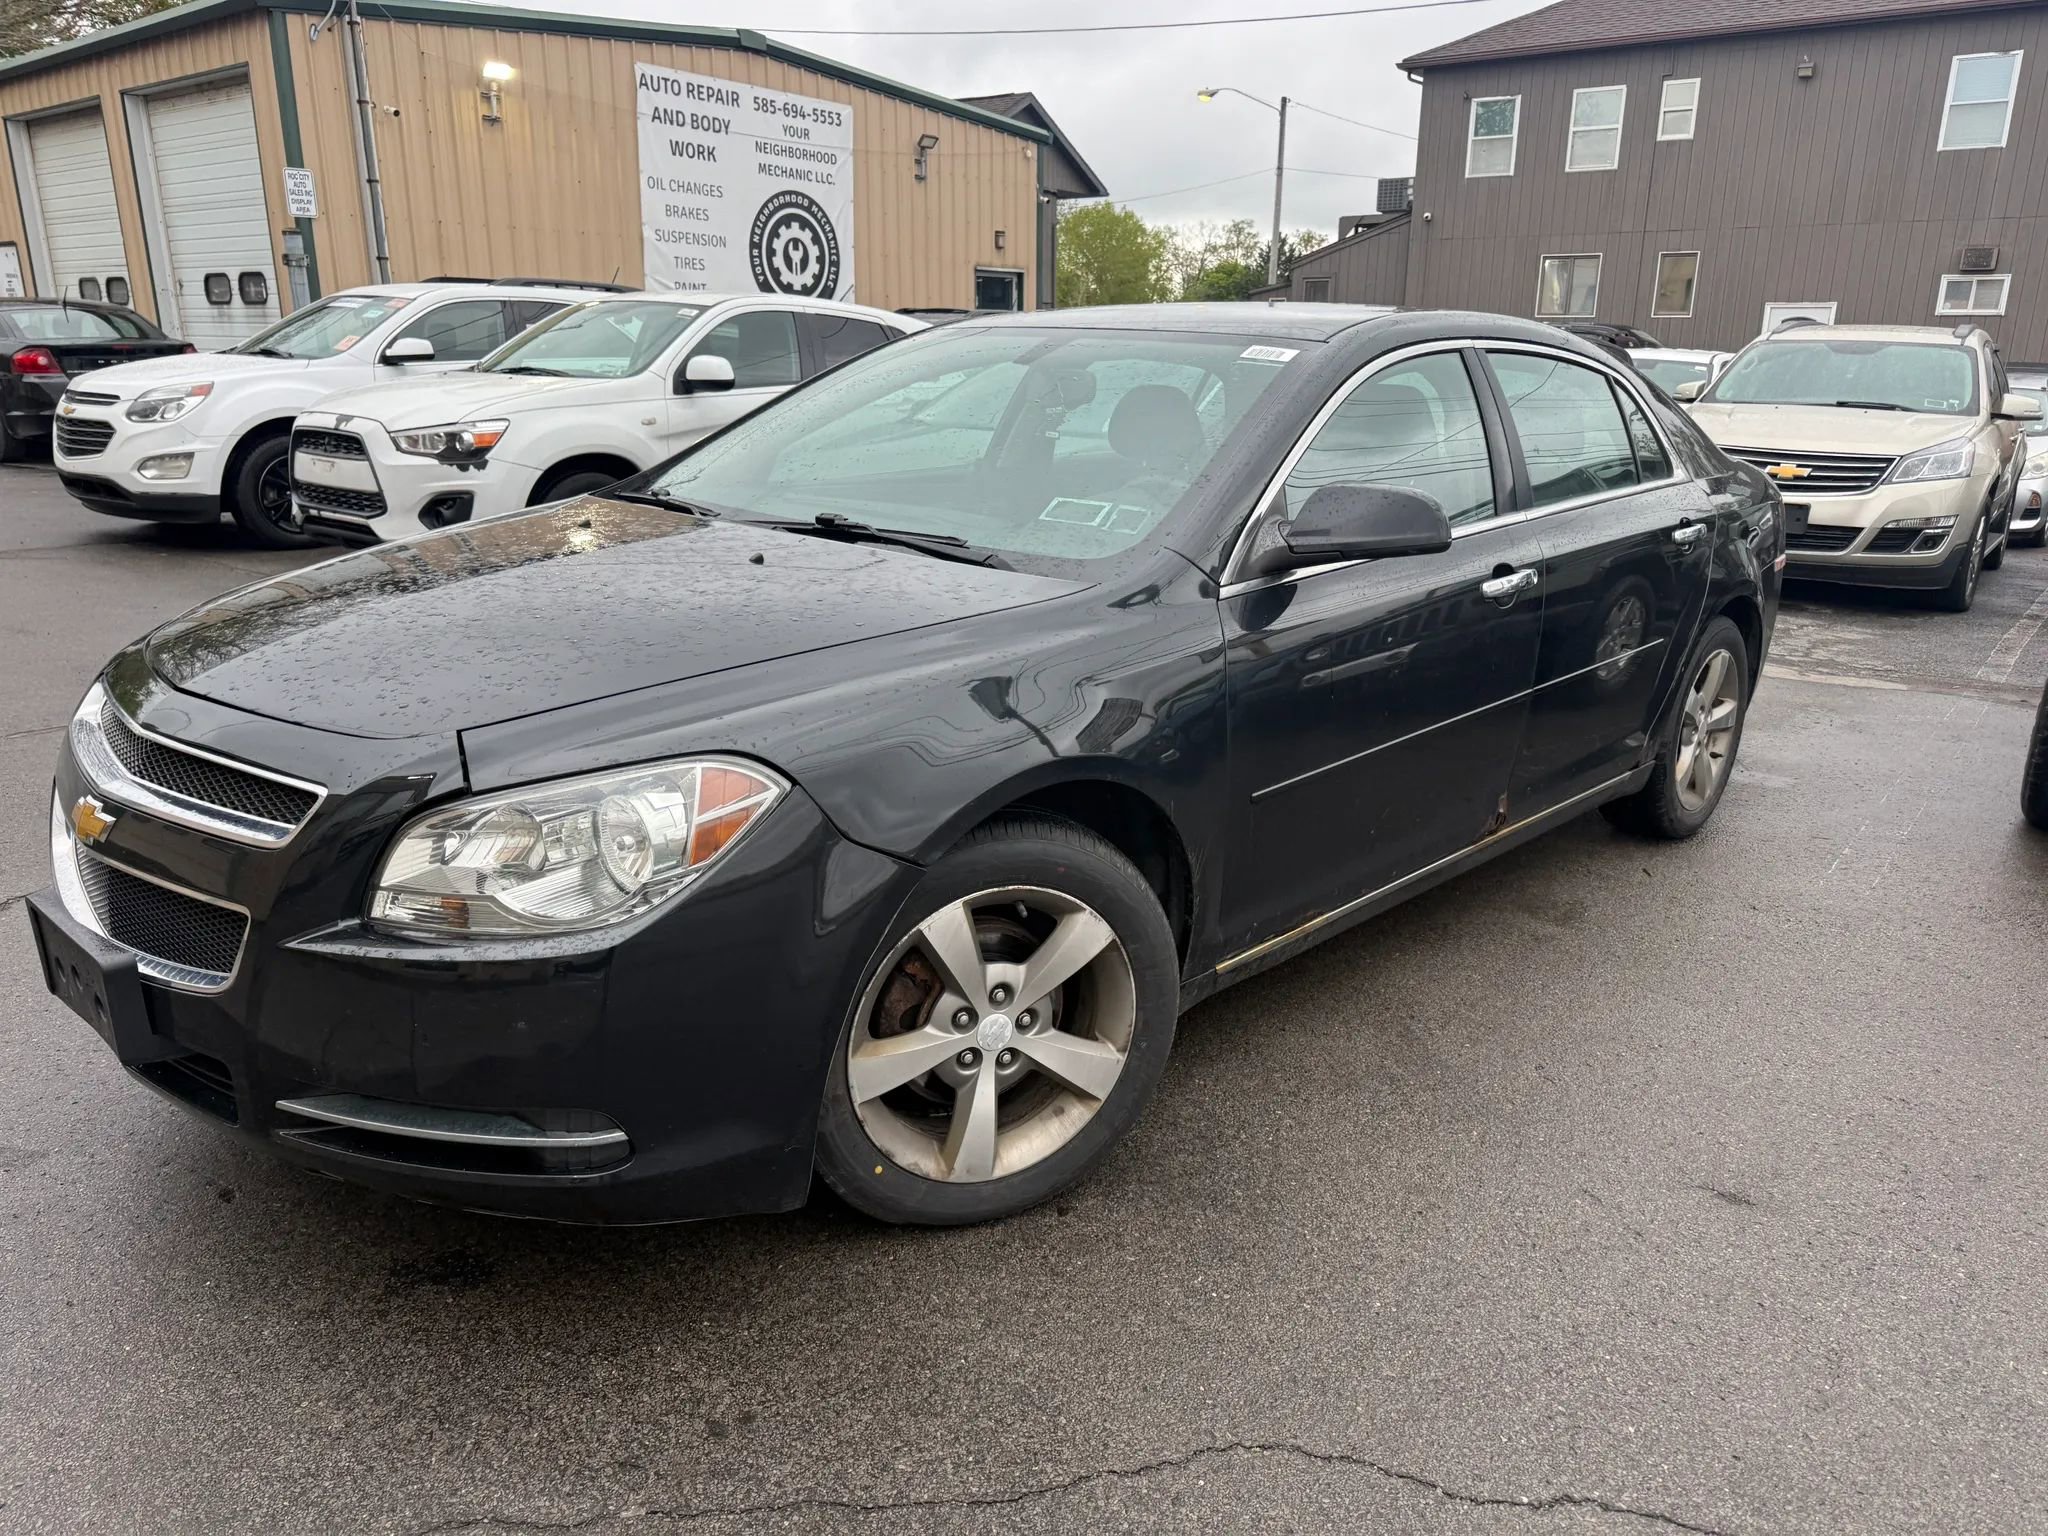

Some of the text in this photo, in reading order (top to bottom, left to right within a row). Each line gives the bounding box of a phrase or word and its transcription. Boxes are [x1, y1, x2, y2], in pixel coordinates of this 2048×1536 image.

[640, 73, 740, 108] AUTO REPAIR
[651, 106, 731, 135] AND BODY
[753, 96, 842, 127] 585-694-5553
[782, 124, 810, 140] YOUR
[669, 139, 717, 163] WORK
[755, 140, 837, 165] NEIGHBORHOOD
[758, 162, 836, 186] MECHANIC LLC.
[289, 188, 304, 196] SALES
[647, 176, 723, 198] OIL CHANGES
[665, 204, 709, 221] BRAKES
[655, 229, 726, 248] SUSPENSION
[752, 194, 838, 289] YOUR NEIGHBORHOOD MECHANIC LLC
[674, 256, 705, 271] TIRES
